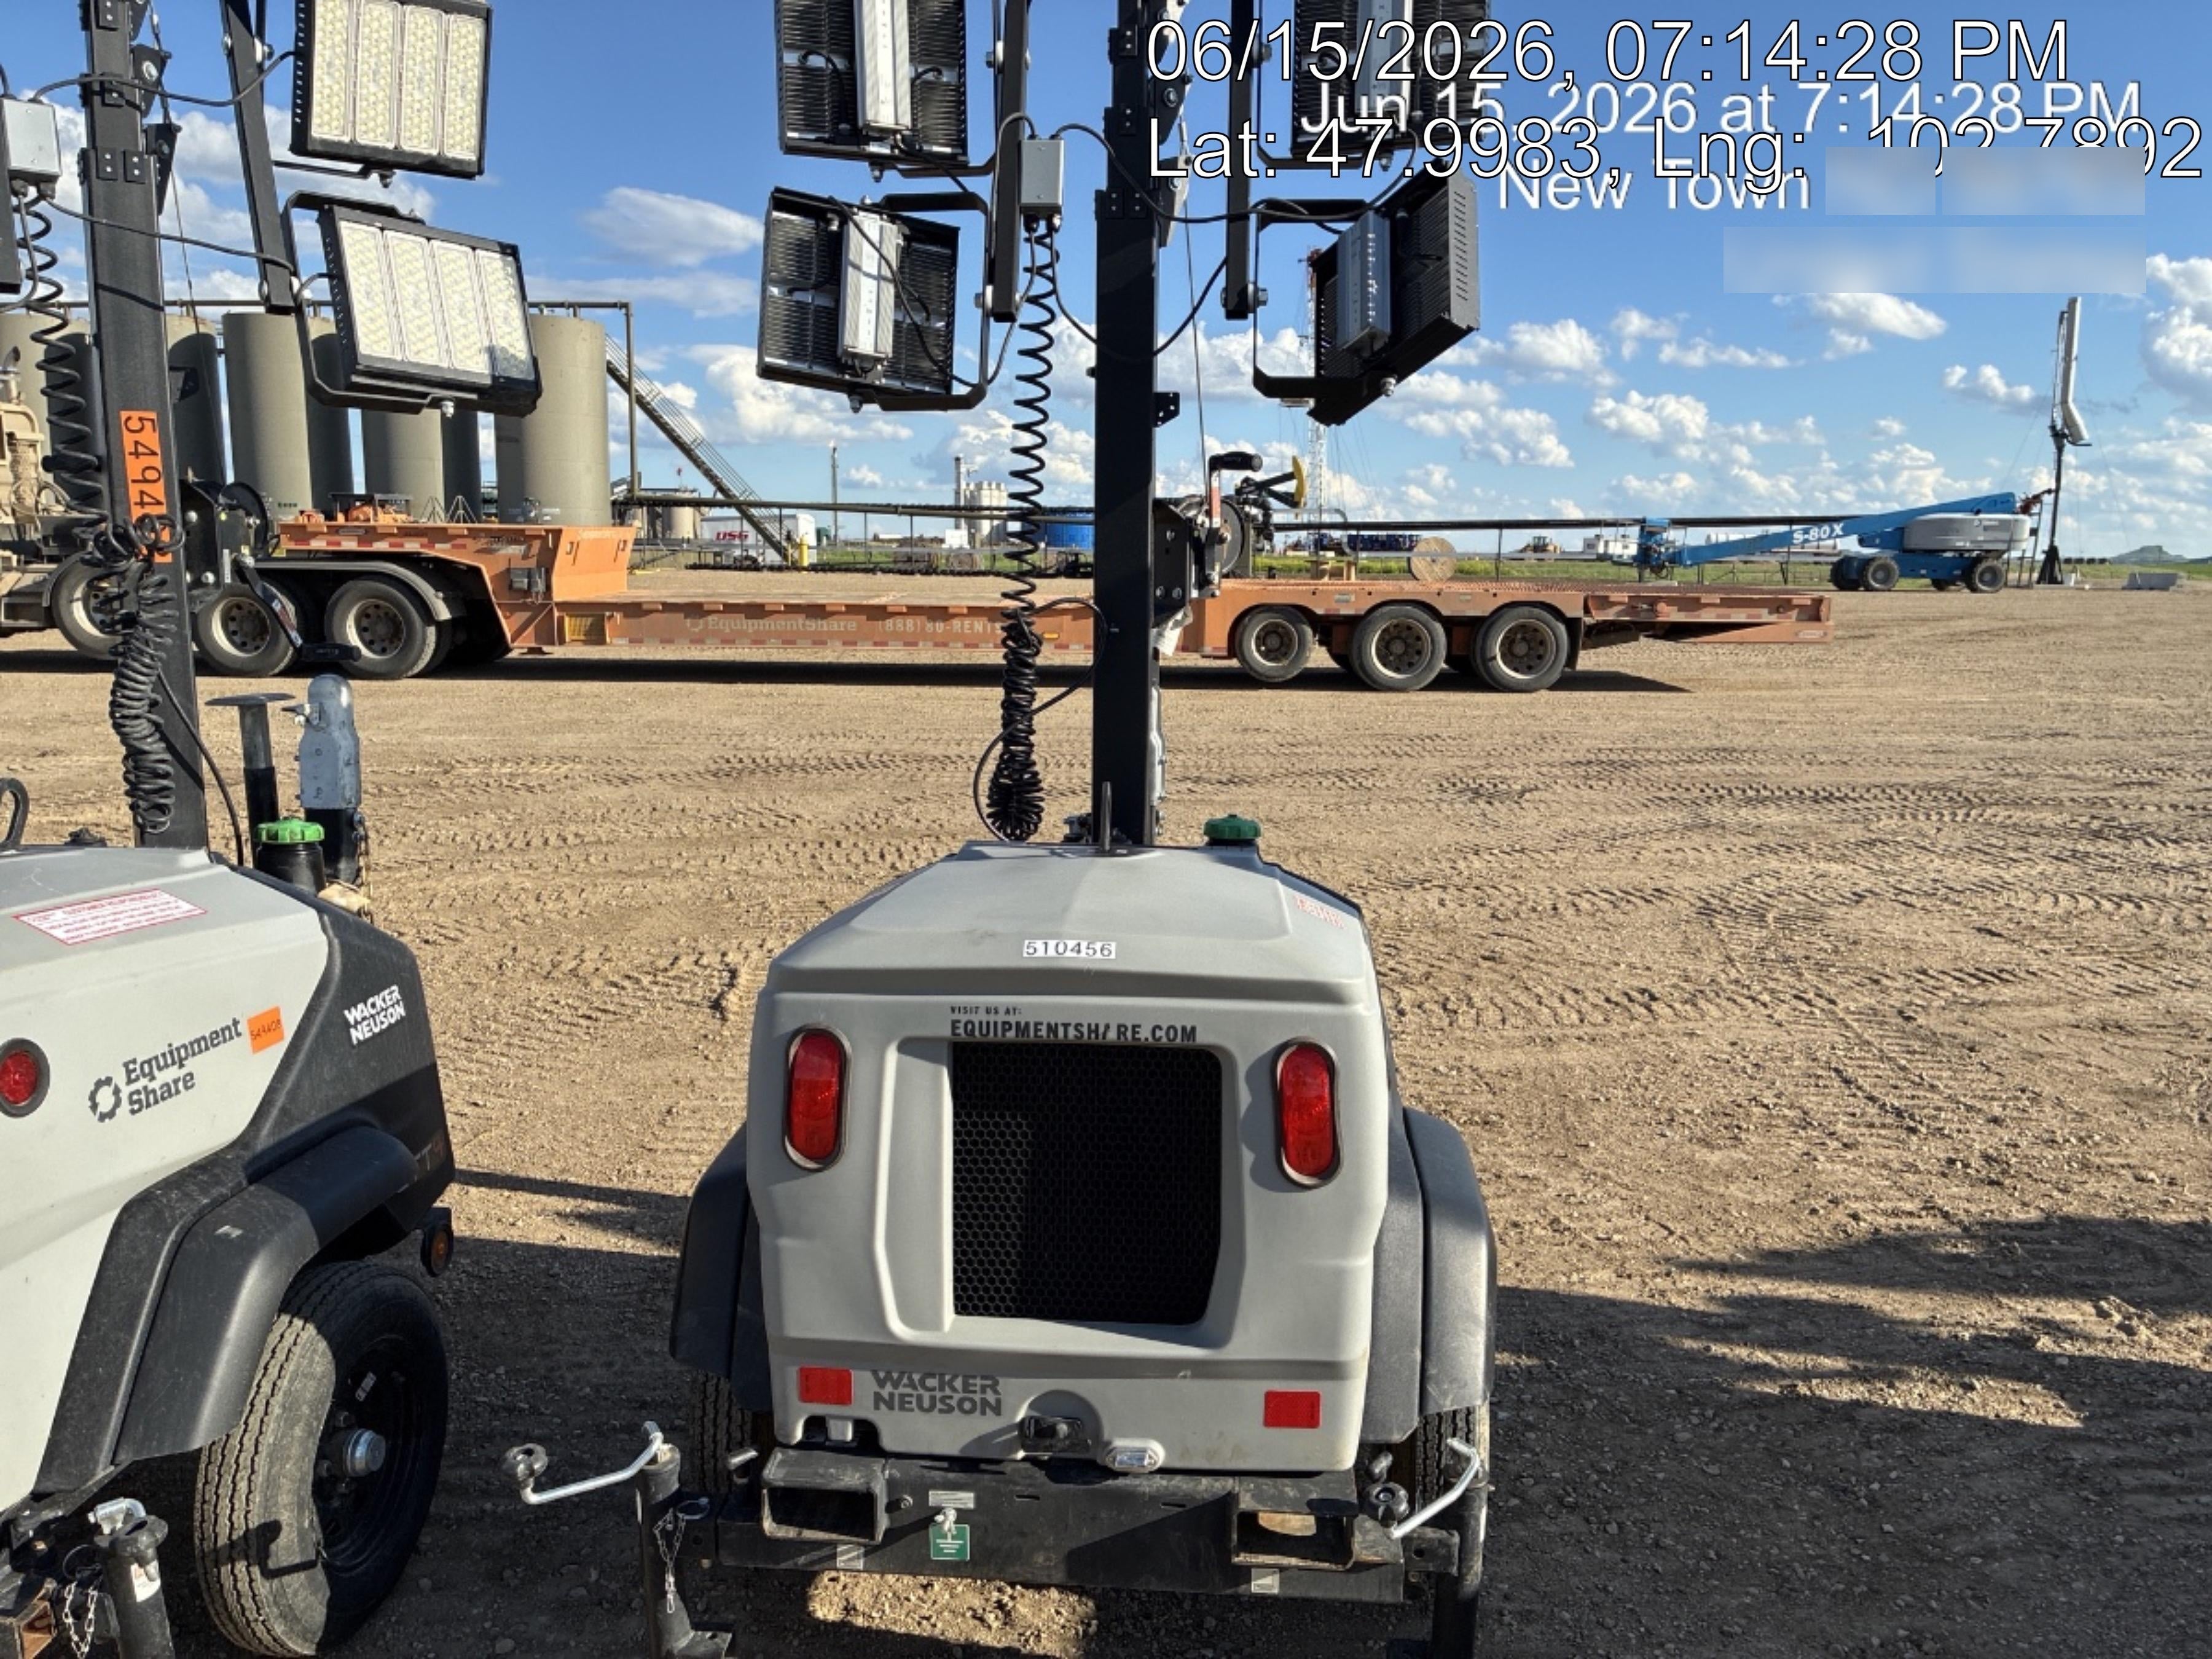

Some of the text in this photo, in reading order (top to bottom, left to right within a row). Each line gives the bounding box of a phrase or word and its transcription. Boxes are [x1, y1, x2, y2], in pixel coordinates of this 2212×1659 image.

[124, 415, 170, 557] 5494
[1026, 941, 1112, 957] 510456
[343, 984, 402, 1026] WACKER
[350, 1000, 406, 1046] NEUSON
[950, 1006, 980, 1014] VISIT
[986, 1006, 1000, 1014] US
[122, 1016, 243, 1086] Equipment
[127, 1071, 197, 1116] Share
[872, 1369, 1002, 1396] WACKER
[873, 1390, 1002, 1416] NEUSON
